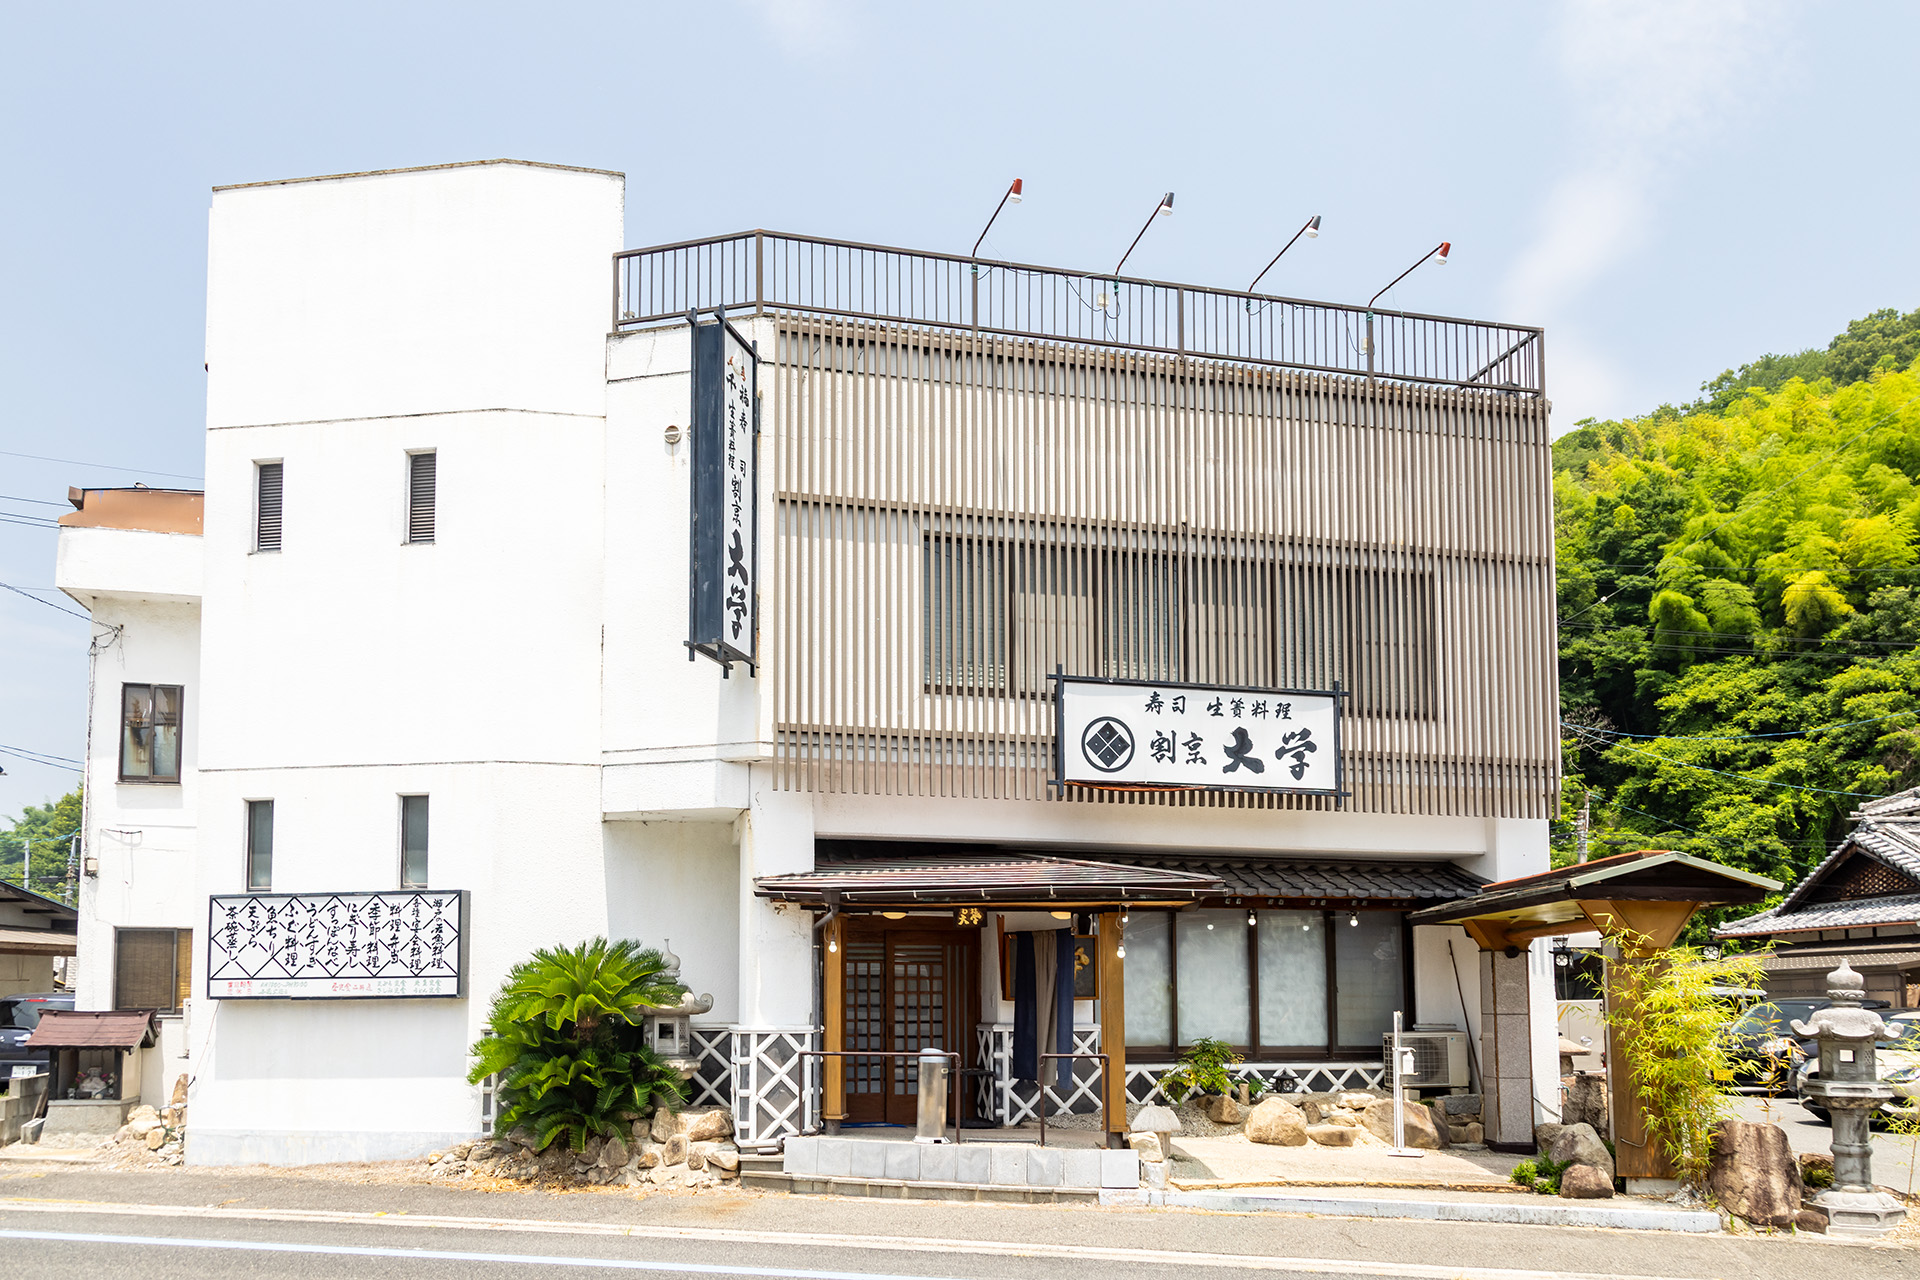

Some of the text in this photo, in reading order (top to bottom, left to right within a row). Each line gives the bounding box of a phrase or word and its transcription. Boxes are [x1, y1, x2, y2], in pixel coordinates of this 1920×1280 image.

[726, 528, 749, 641] 大学
[1144, 691, 1187, 715] 寿司
[1149, 725, 1318, 781] 割烹 大学
[225, 906, 240, 962] 茶碗蒸し
[246, 906, 261, 949] 天ぷら
[266, 905, 279, 958] 魚ちり
[285, 902, 300, 967] ふぐ料理
[305, 902, 320, 968] うどんすき
[325, 902, 341, 967] すっぽんなべ
[345, 902, 361, 969] にぎり寿し
[366, 902, 382, 969] 季節料理
[387, 902, 403, 965] 料理弁当
